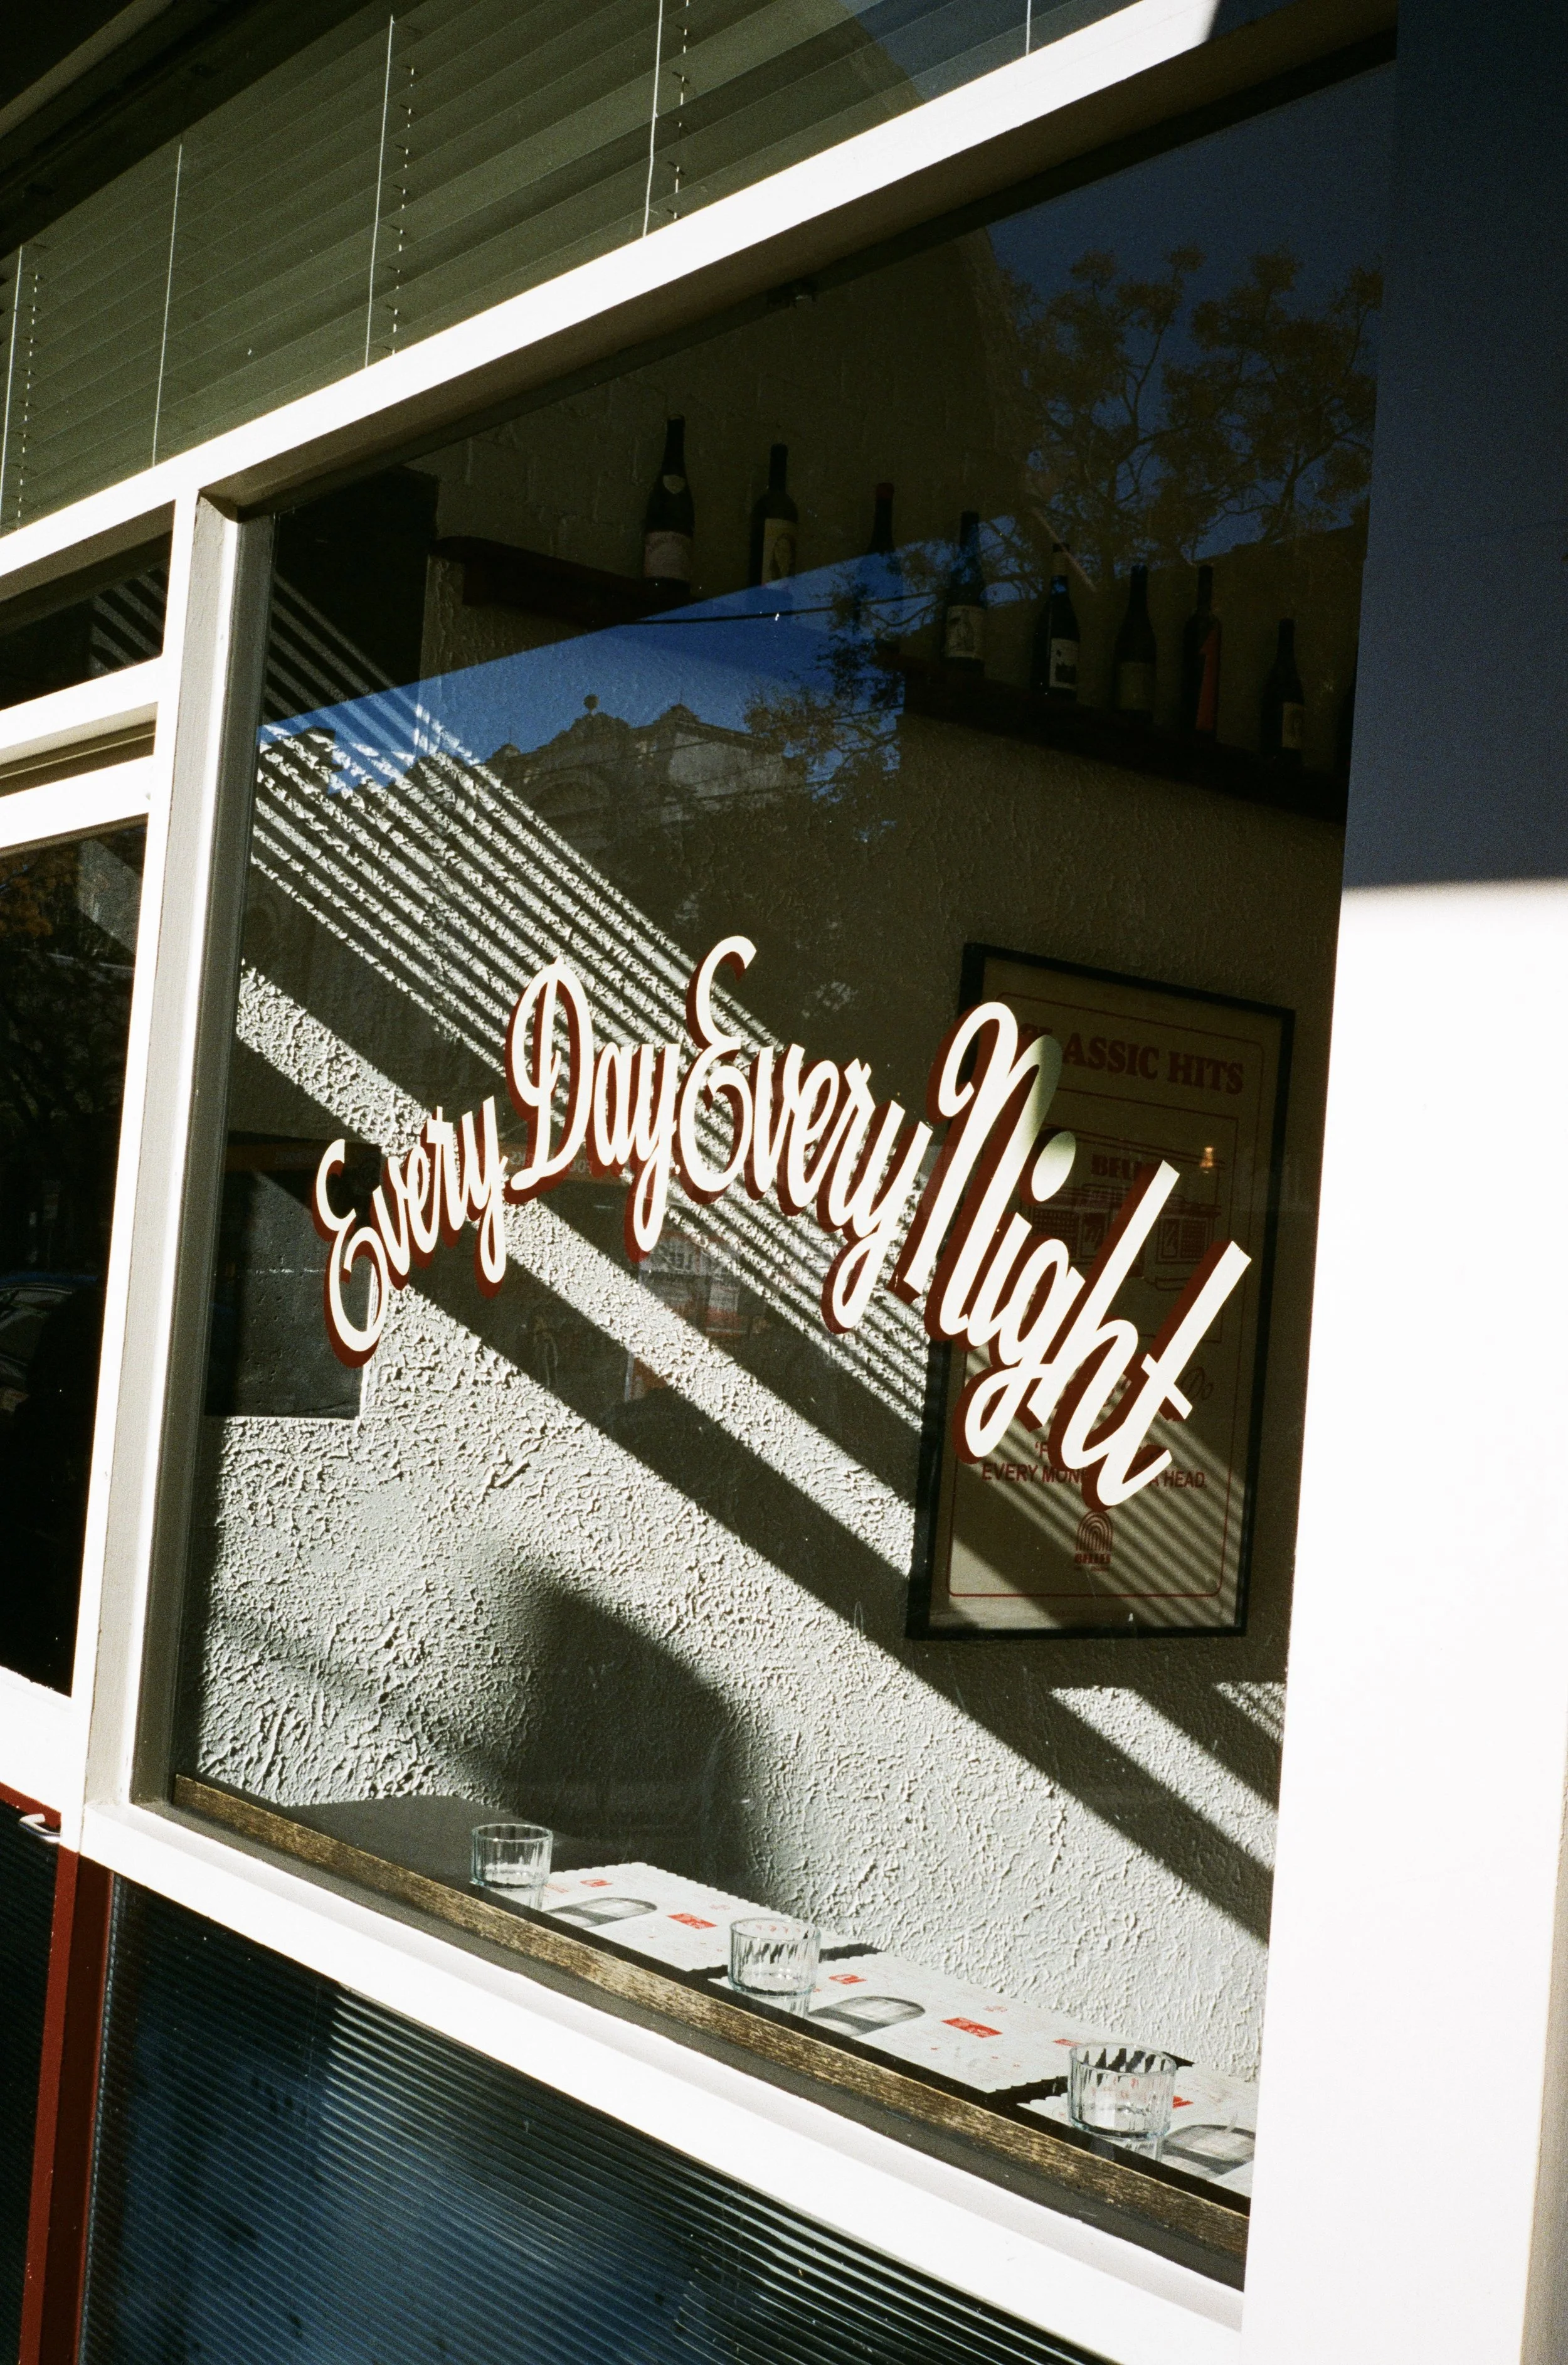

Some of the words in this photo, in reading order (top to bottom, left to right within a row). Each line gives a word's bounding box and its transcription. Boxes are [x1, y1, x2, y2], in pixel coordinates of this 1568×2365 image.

[1019, 1023, 1159, 1080] ASSIC
[1167, 1051, 1244, 1095] HITS
[313, 1096, 507, 1368] Every
[504, 957, 677, 1260] Day
[676, 936, 933, 1334] Every
[888, 1002, 1252, 1512] Night
[982, 1462, 1038, 1482] EVERY
